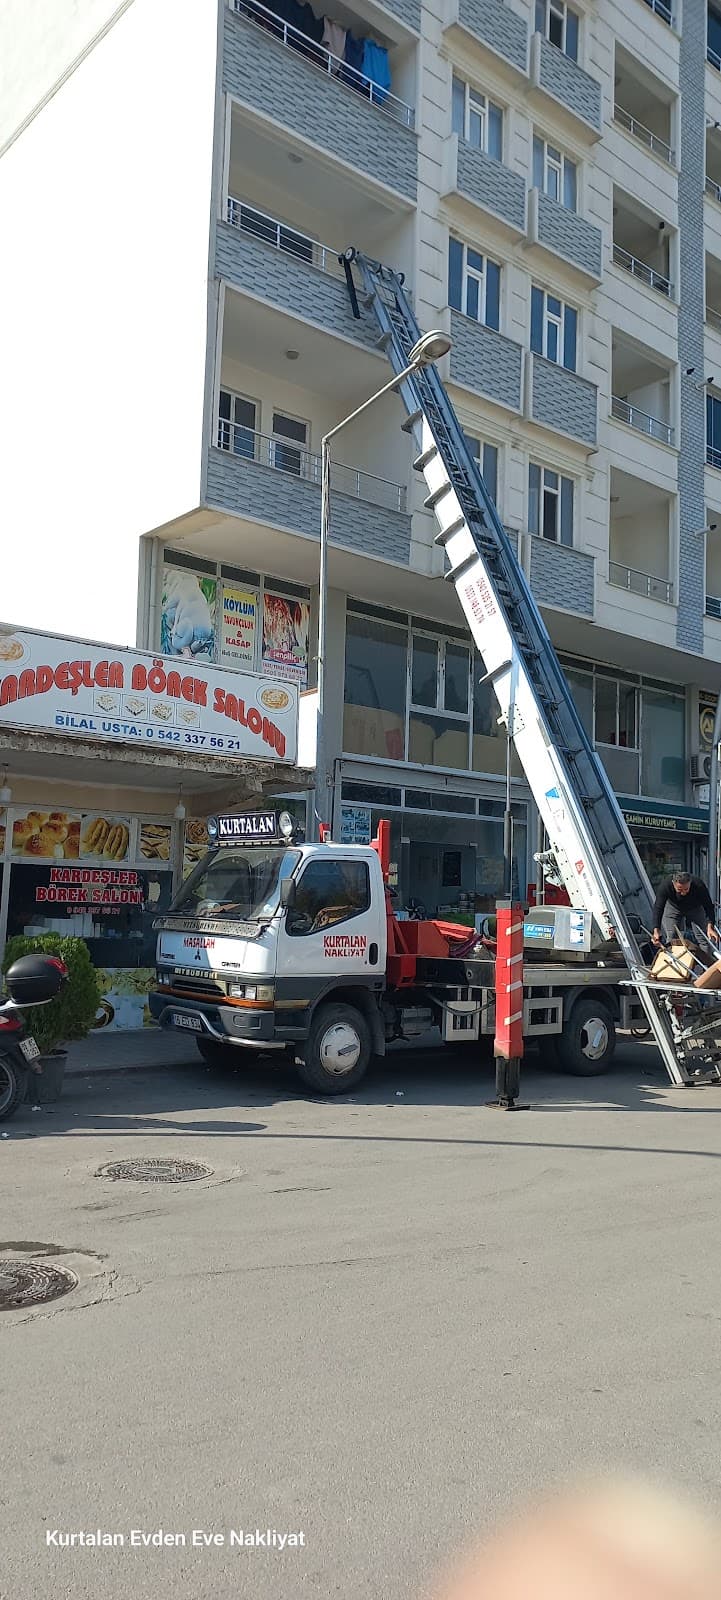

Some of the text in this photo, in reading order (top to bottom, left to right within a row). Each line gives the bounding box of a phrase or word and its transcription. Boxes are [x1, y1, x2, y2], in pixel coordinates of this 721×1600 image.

[223, 595, 255, 616] KÖYLÜM
[225, 637, 251, 648] KASAP
[236, 630, 243, 638] &
[0, 659, 286, 757] ARDEŞLER BÖREK SALONU
[55, 714, 241, 750] BİLAL USTA: 0 542 337 56 21
[219, 816, 274, 835] KURTALAN
[50, 867, 138, 886] KARDEŞLER
[36, 883, 88, 903] BÖREK
[323, 935, 367, 948] KURTALAN
[174, 967, 218, 979] MITSUBISHI
